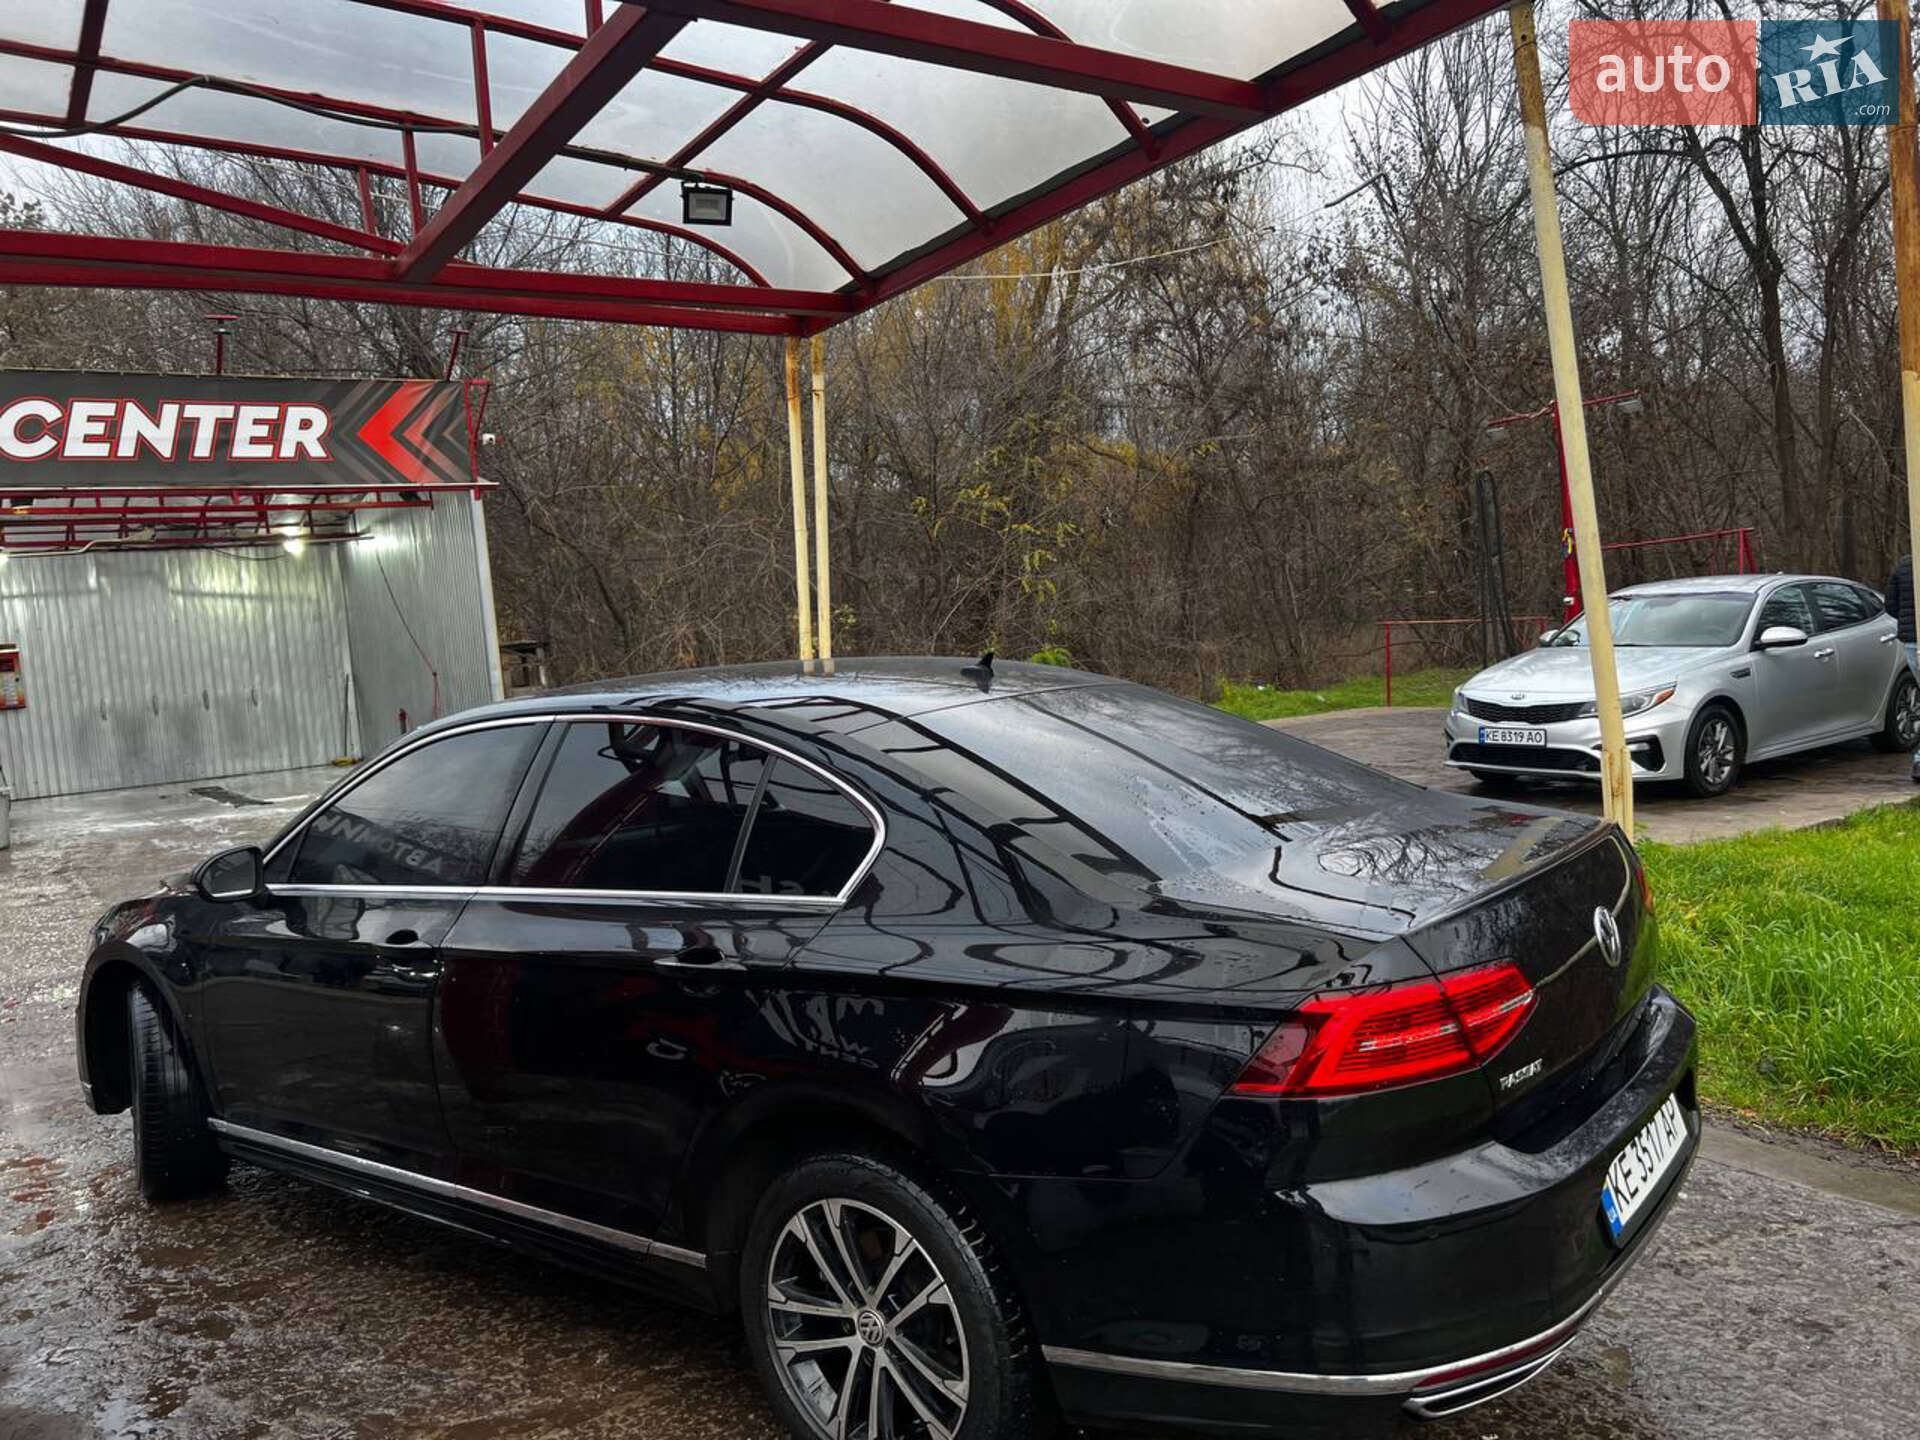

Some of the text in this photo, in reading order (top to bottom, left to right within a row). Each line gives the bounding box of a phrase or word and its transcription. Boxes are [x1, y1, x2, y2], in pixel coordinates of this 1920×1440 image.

[0, 397, 333, 460] CENTER
[1486, 730, 1543, 744] KE 8319 AO
[1608, 1151, 1639, 1213] KE
[1630, 1119, 1665, 1183] 3517
[1659, 1100, 1678, 1147] AP
